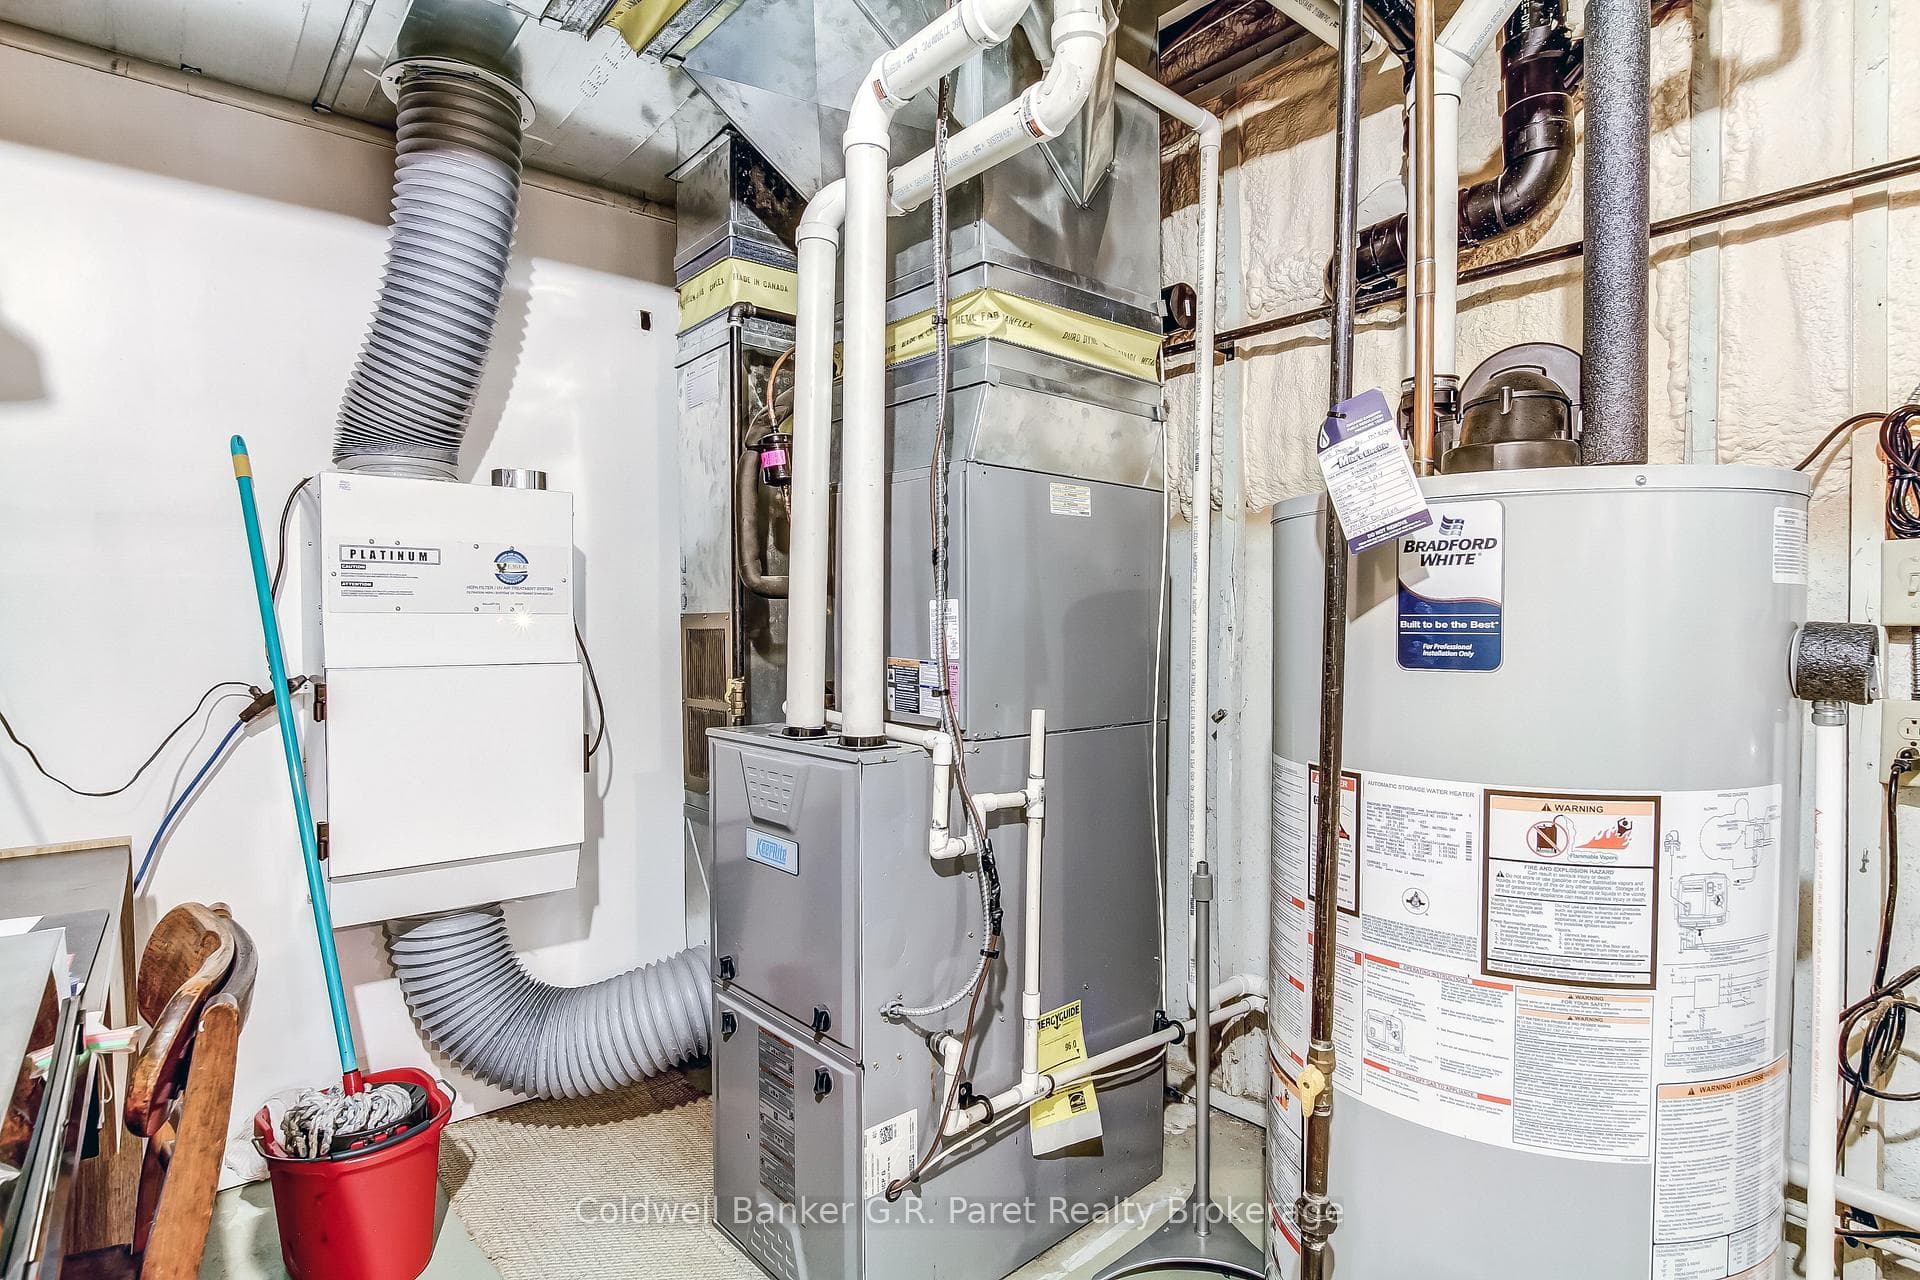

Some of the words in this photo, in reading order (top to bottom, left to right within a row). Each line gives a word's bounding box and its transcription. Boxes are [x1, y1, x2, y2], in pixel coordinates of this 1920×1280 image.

[763, 280, 788, 293] CANADA
[1403, 538, 1497, 553] BRADFORD
[350, 549, 428, 562] PLATINUM
[1420, 553, 1476, 567] WHITE
[1400, 621, 1420, 629] Built
[1423, 621, 1433, 629] to
[1435, 621, 1448, 629] be
[1451, 621, 1467, 629] the
[1459, 650, 1475, 658] Only
[1367, 780, 1397, 789] AUTOMATIC
[1398, 785, 1426, 793] STORAGE
[1426, 788, 1449, 796] WATER
[1449, 790, 1475, 798] HEATER
[1554, 805, 1603, 814] WARNING
[1699, 1083, 1732, 1093] WARNING
